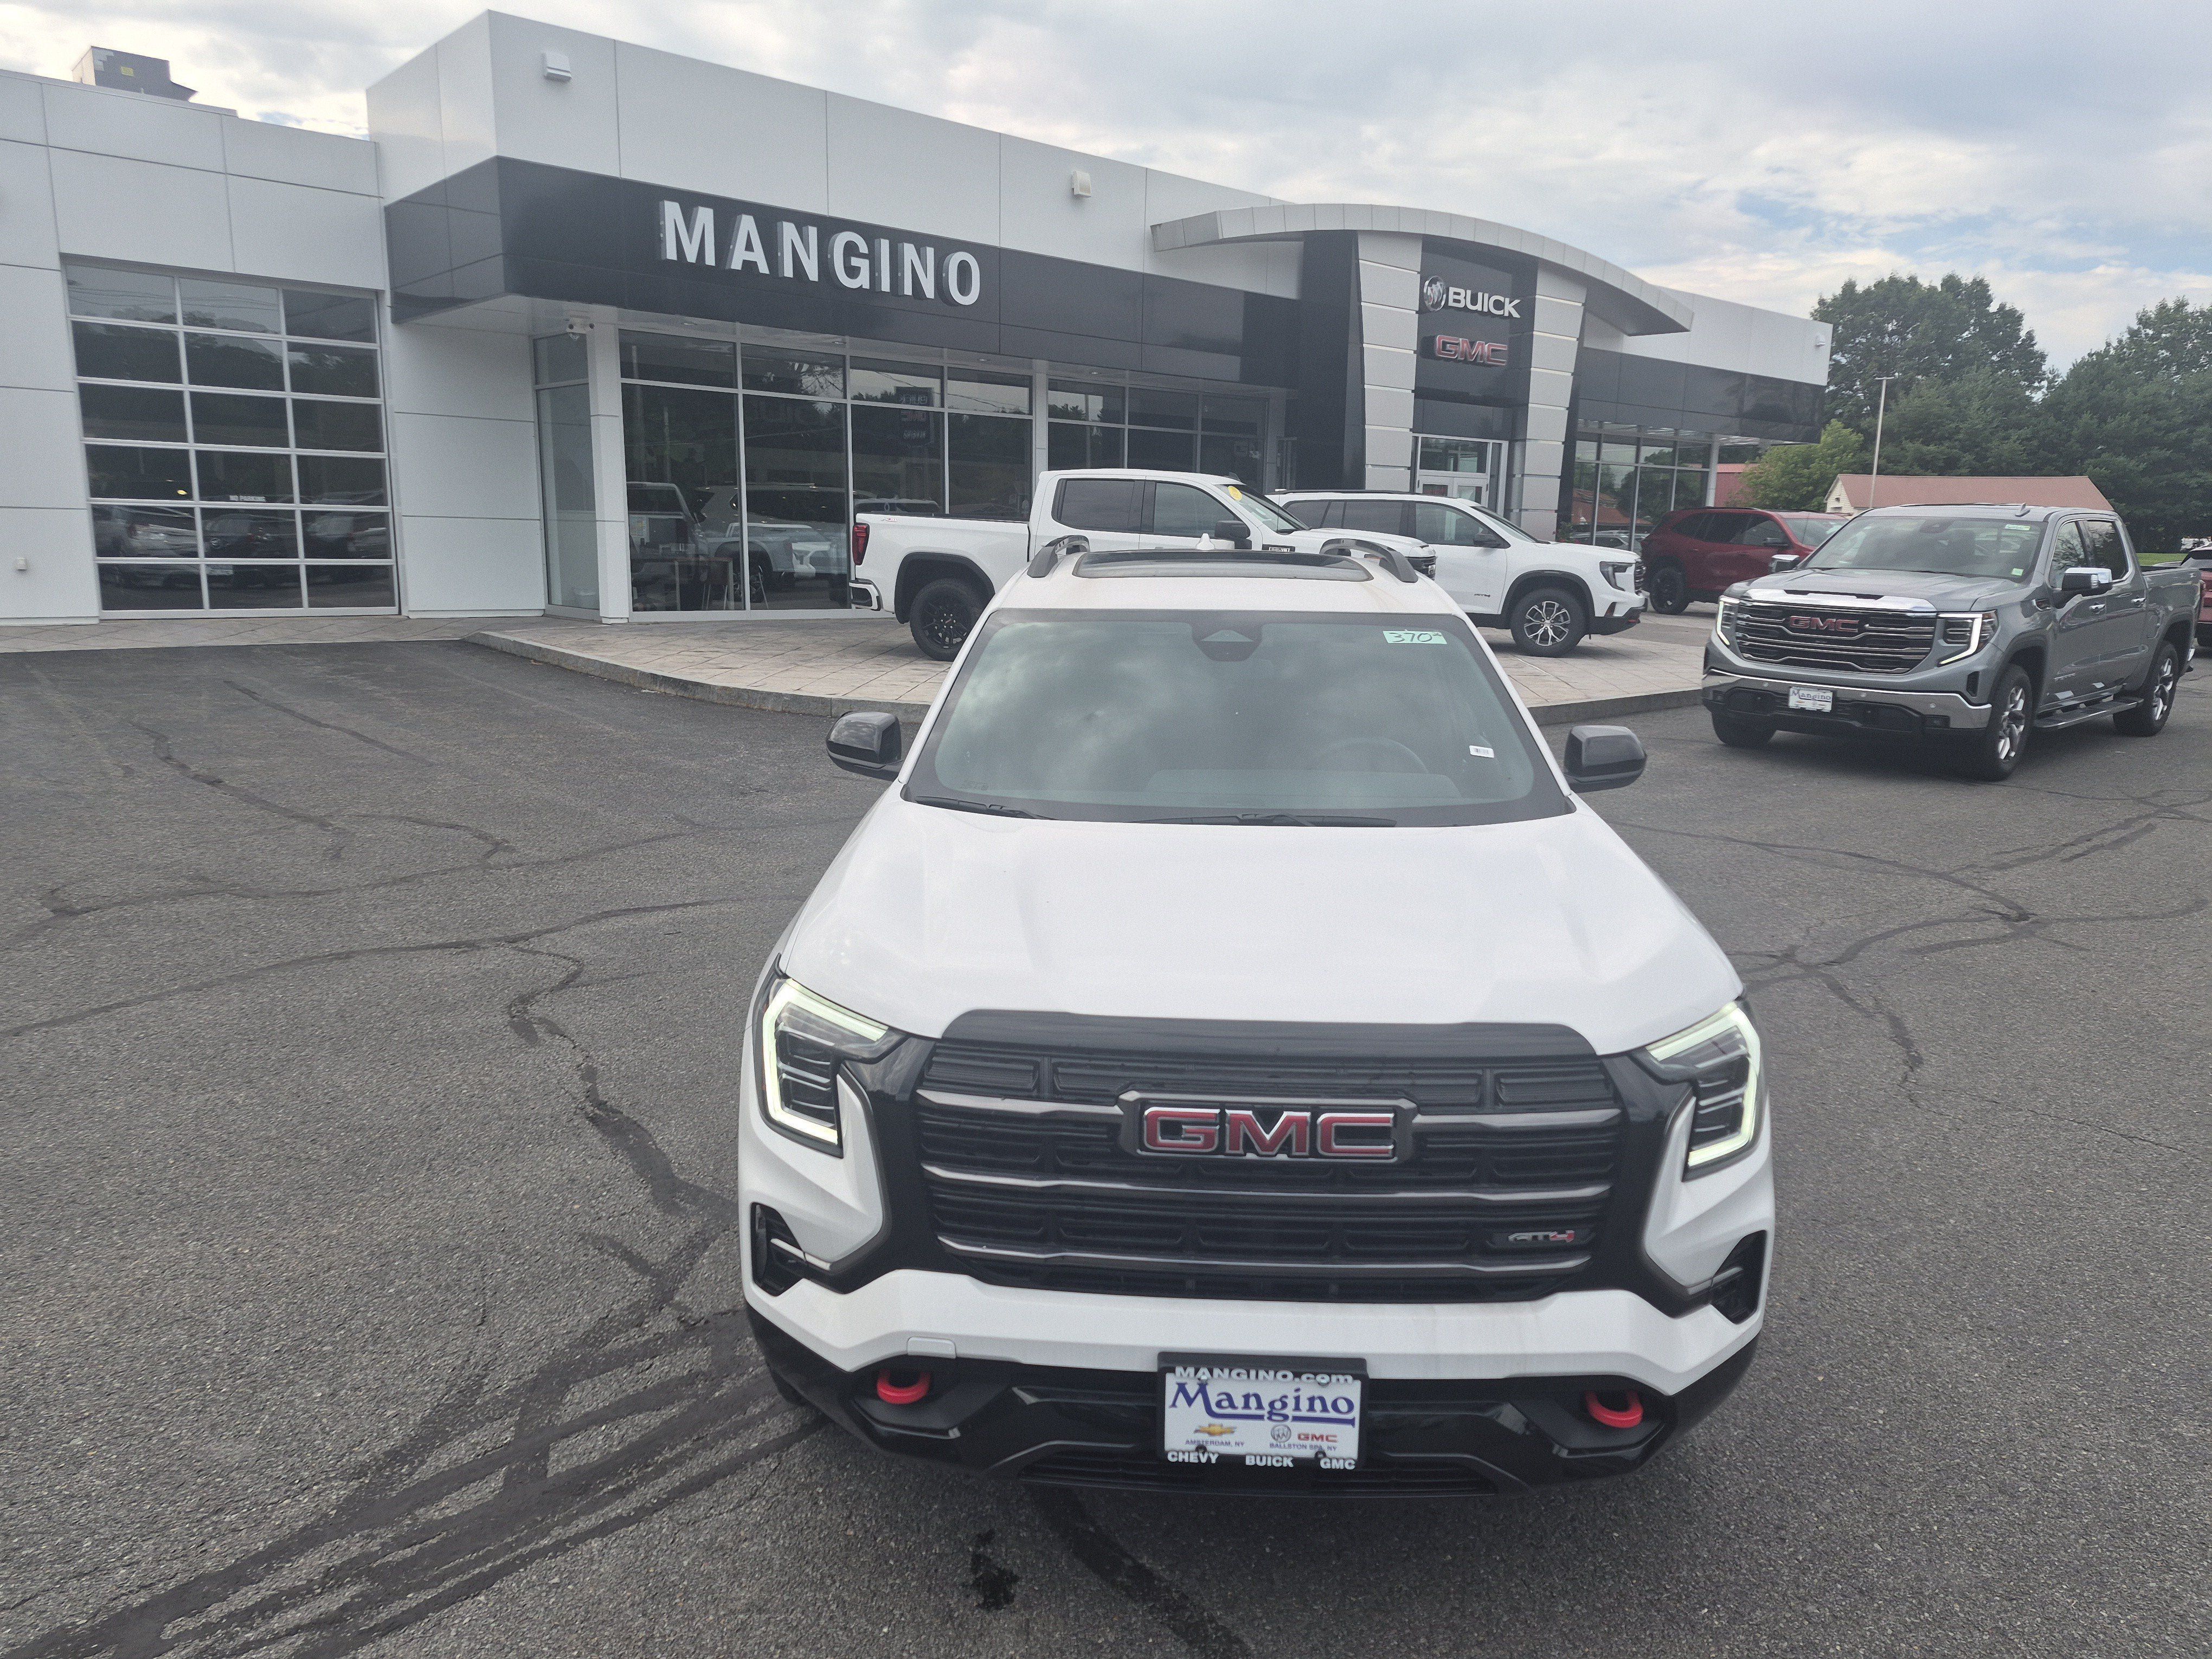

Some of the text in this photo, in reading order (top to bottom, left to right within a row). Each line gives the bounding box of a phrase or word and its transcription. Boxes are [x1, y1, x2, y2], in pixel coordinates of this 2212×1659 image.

[660, 200, 980, 306] MANGINO
[1448, 286, 1521, 318] BUICK
[1436, 335, 1508, 366] GMC
[1790, 615, 1860, 633] GMC
[1791, 690, 1831, 702] Mangino
[1143, 1107, 1394, 1157] GMC
[1175, 1366, 1353, 1384] MANGINO.com
[1168, 1382, 1355, 1424] Mangino
[1297, 1432, 1339, 1443] GMC
[1167, 1450, 1356, 1470] CHEVY BUICK GMC
